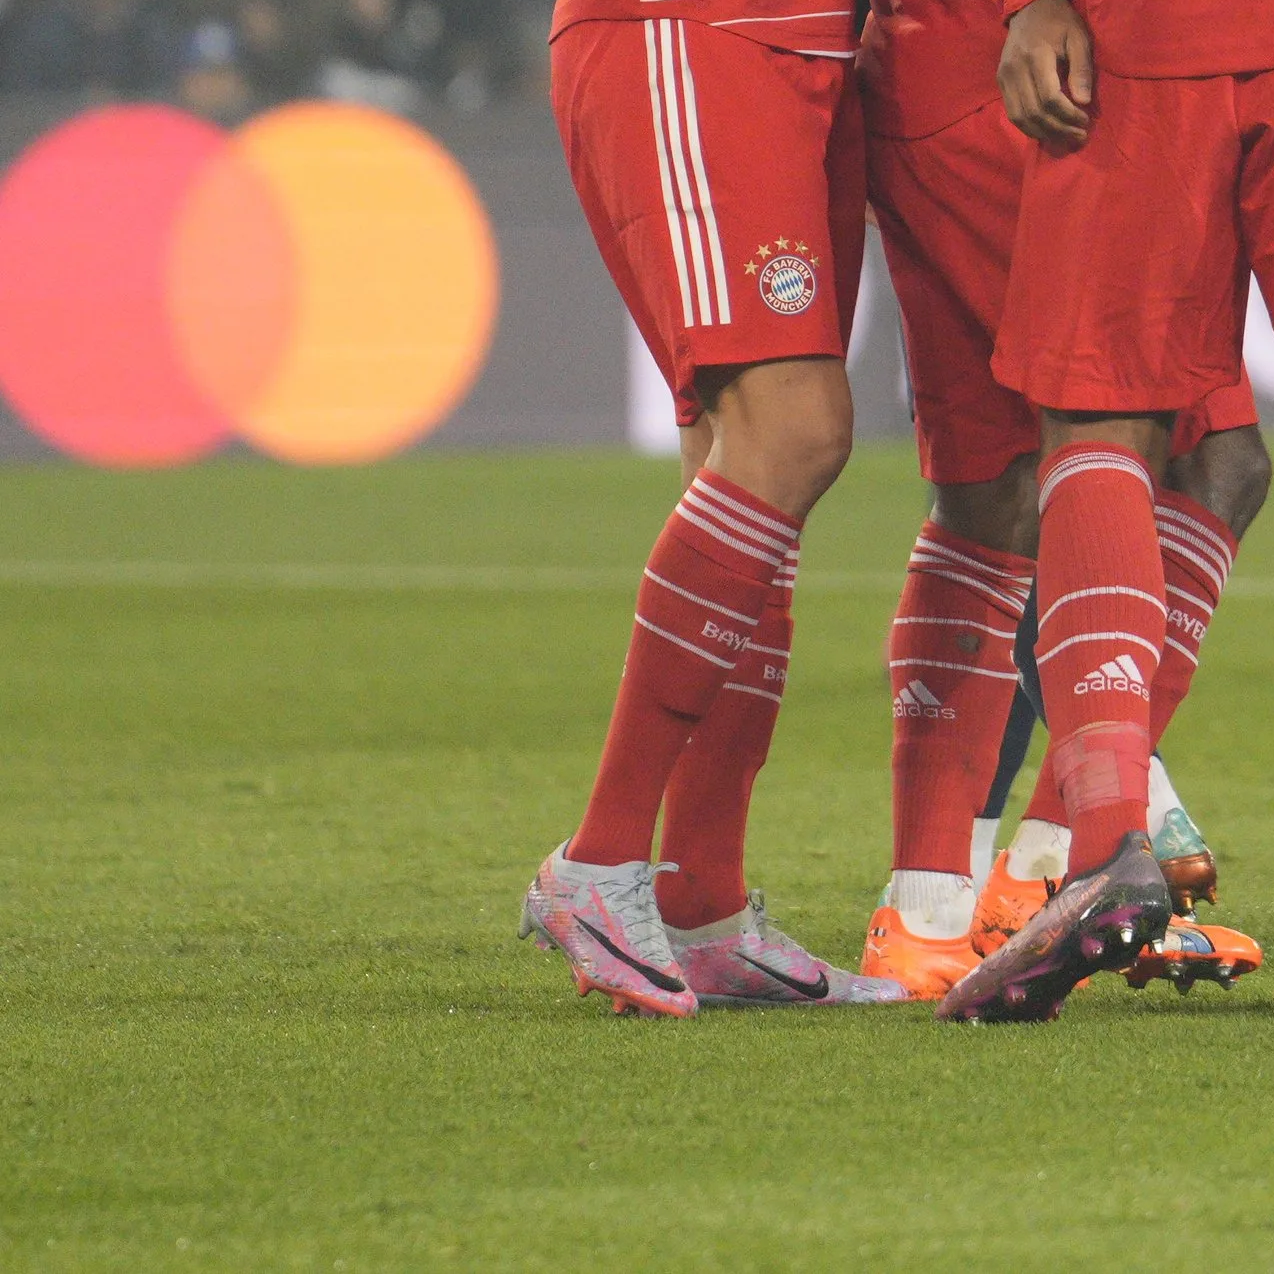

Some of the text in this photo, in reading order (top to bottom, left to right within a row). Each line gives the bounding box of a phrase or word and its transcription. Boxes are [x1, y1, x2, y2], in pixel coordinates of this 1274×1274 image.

[763, 259, 811, 284] FC BAYERN
[1074, 676, 1150, 702] adidas
